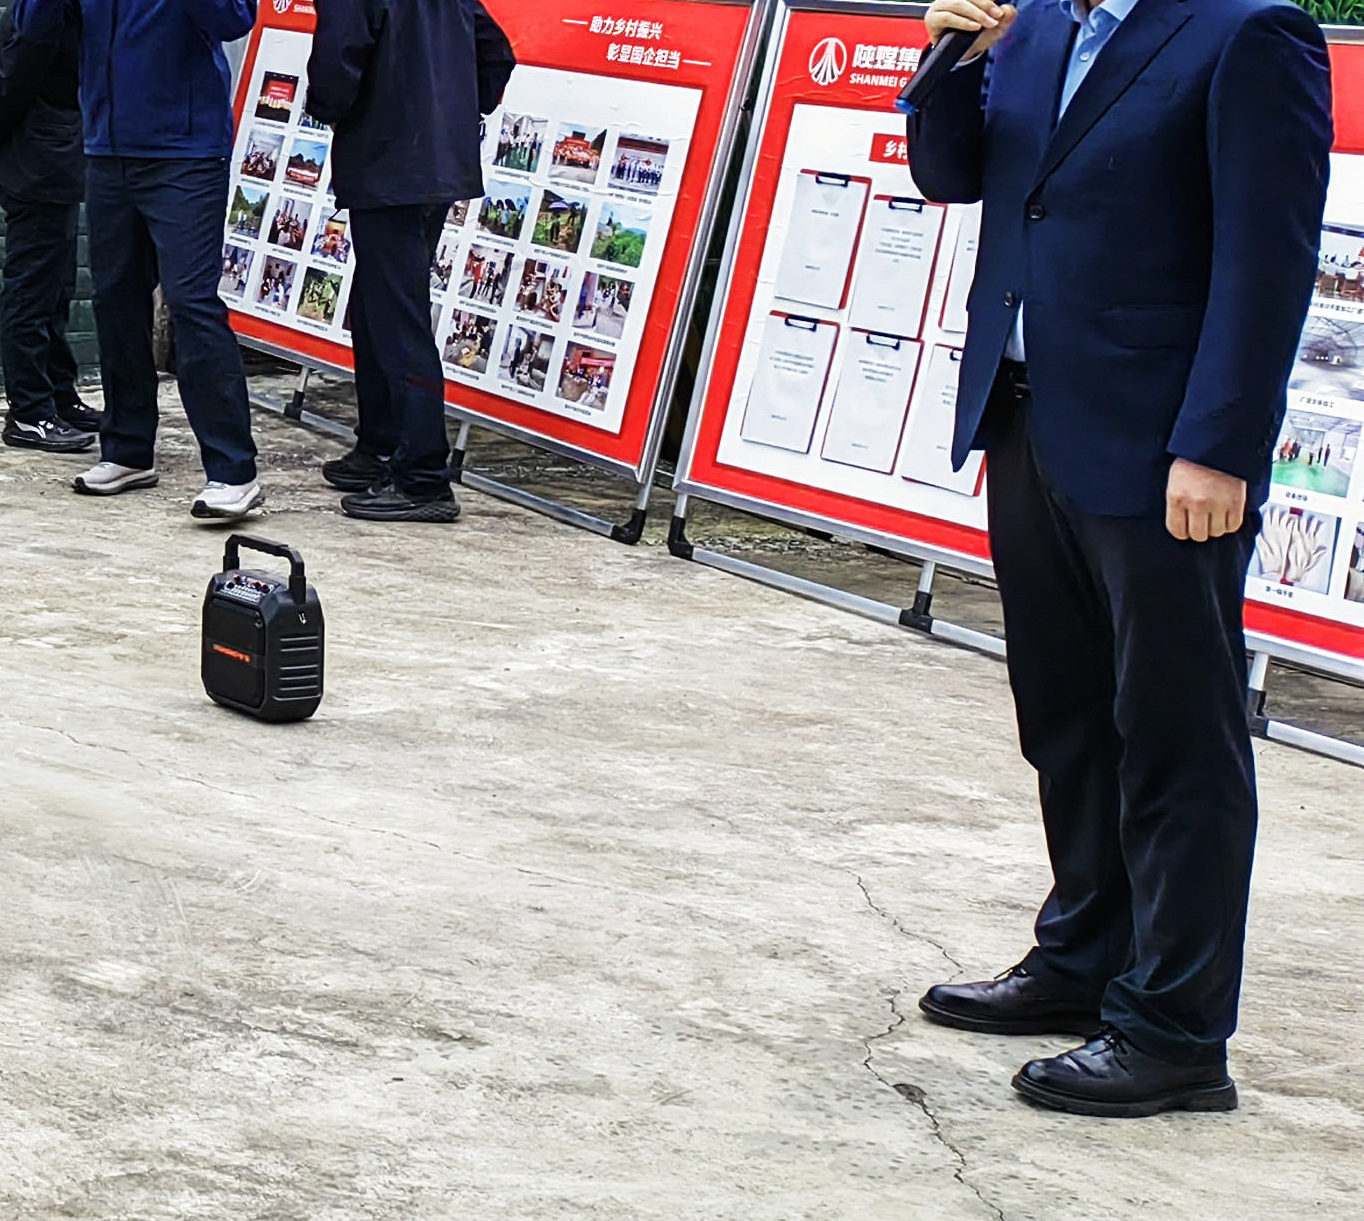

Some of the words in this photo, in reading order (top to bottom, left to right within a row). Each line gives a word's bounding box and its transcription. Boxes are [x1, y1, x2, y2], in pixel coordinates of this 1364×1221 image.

[588, 15, 664, 40] 助力乡村振兴
[606, 43, 682, 70] 彰显国企担当
[849, 73, 898, 88] SHANMEI
